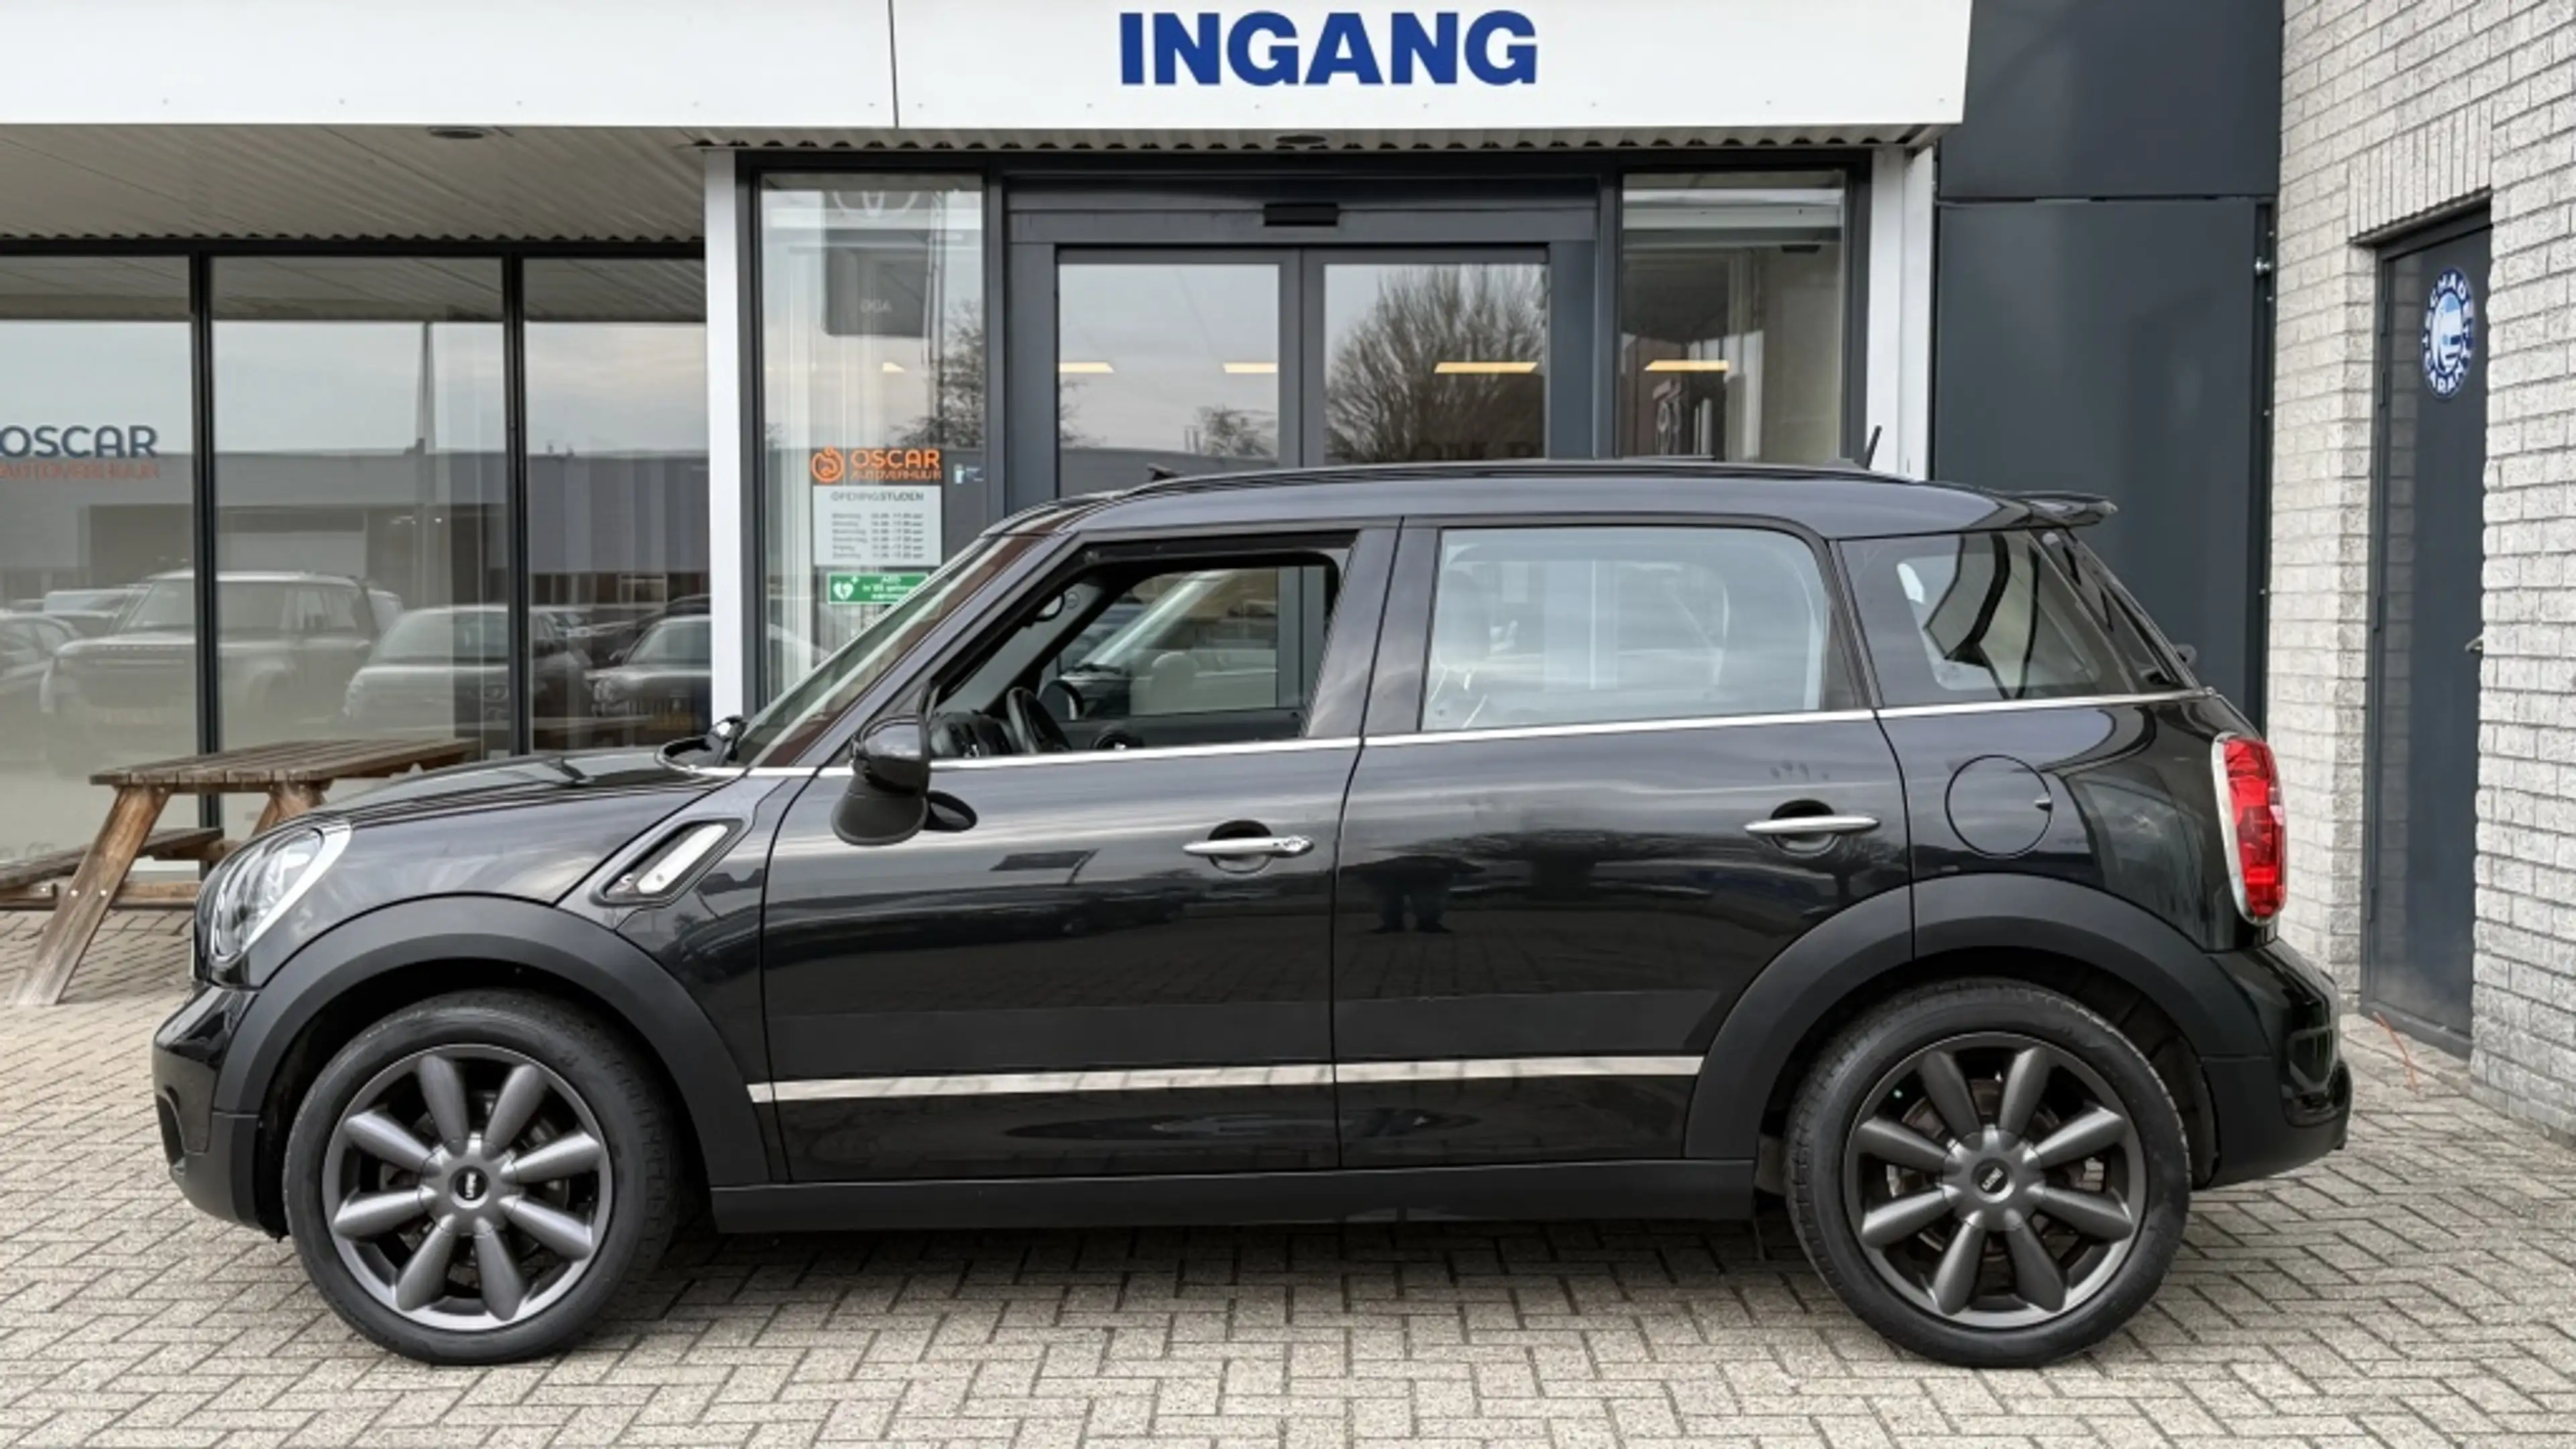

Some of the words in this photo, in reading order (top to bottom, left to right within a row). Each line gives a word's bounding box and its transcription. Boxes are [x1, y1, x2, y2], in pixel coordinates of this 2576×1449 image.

[1120, 11, 1537, 86] INGANG
[0, 425, 159, 458] OSCAR
[850, 449, 940, 468] OSCAR
